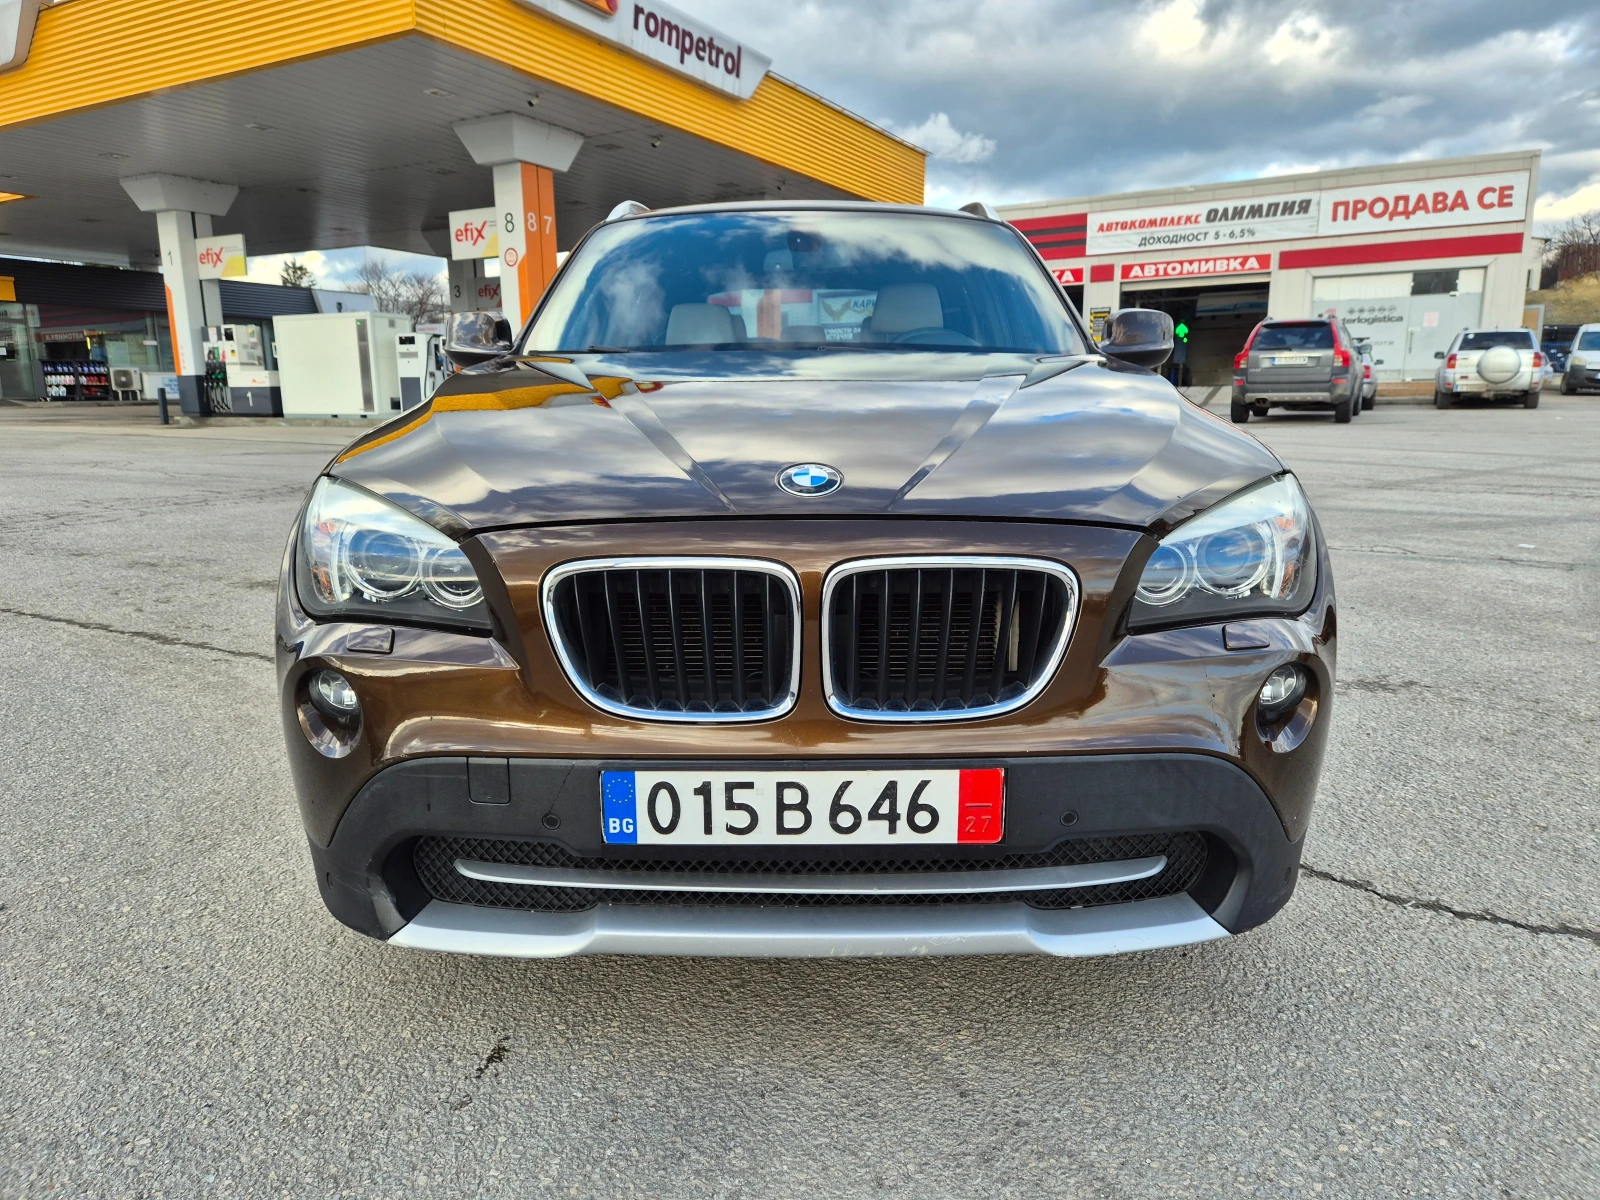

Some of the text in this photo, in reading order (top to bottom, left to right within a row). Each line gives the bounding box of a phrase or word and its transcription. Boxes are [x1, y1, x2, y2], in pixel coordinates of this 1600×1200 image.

[633, 3, 742, 78] rompetrol
[1331, 185, 1514, 222] ПРОДАВА СЕ
[505, 212, 515, 233] 8
[527, 212, 537, 232] 8
[543, 215, 552, 235] 7
[1097, 198, 1312, 233] АВТОКОМПЛЕКС ОЛИМПИЯ
[455, 220, 487, 246] efix
[1138, 231, 1209, 248] ДОХОДНОСТ
[1213, 231, 1220, 240] 5
[1228, 227, 1256, 241] 6,5%
[167, 250, 173, 266] 1
[199, 246, 225, 269] efix
[1129, 256, 1260, 278] АВТОМИВКА
[454, 285, 461, 298] 3
[478, 283, 500, 300] efix
[1340, 313, 1404, 325] terlogistica
[246, 390, 253, 407] 1
[646, 779, 941, 836] 015 B 646
[608, 818, 635, 834] BG
[965, 815, 992, 834] 27
